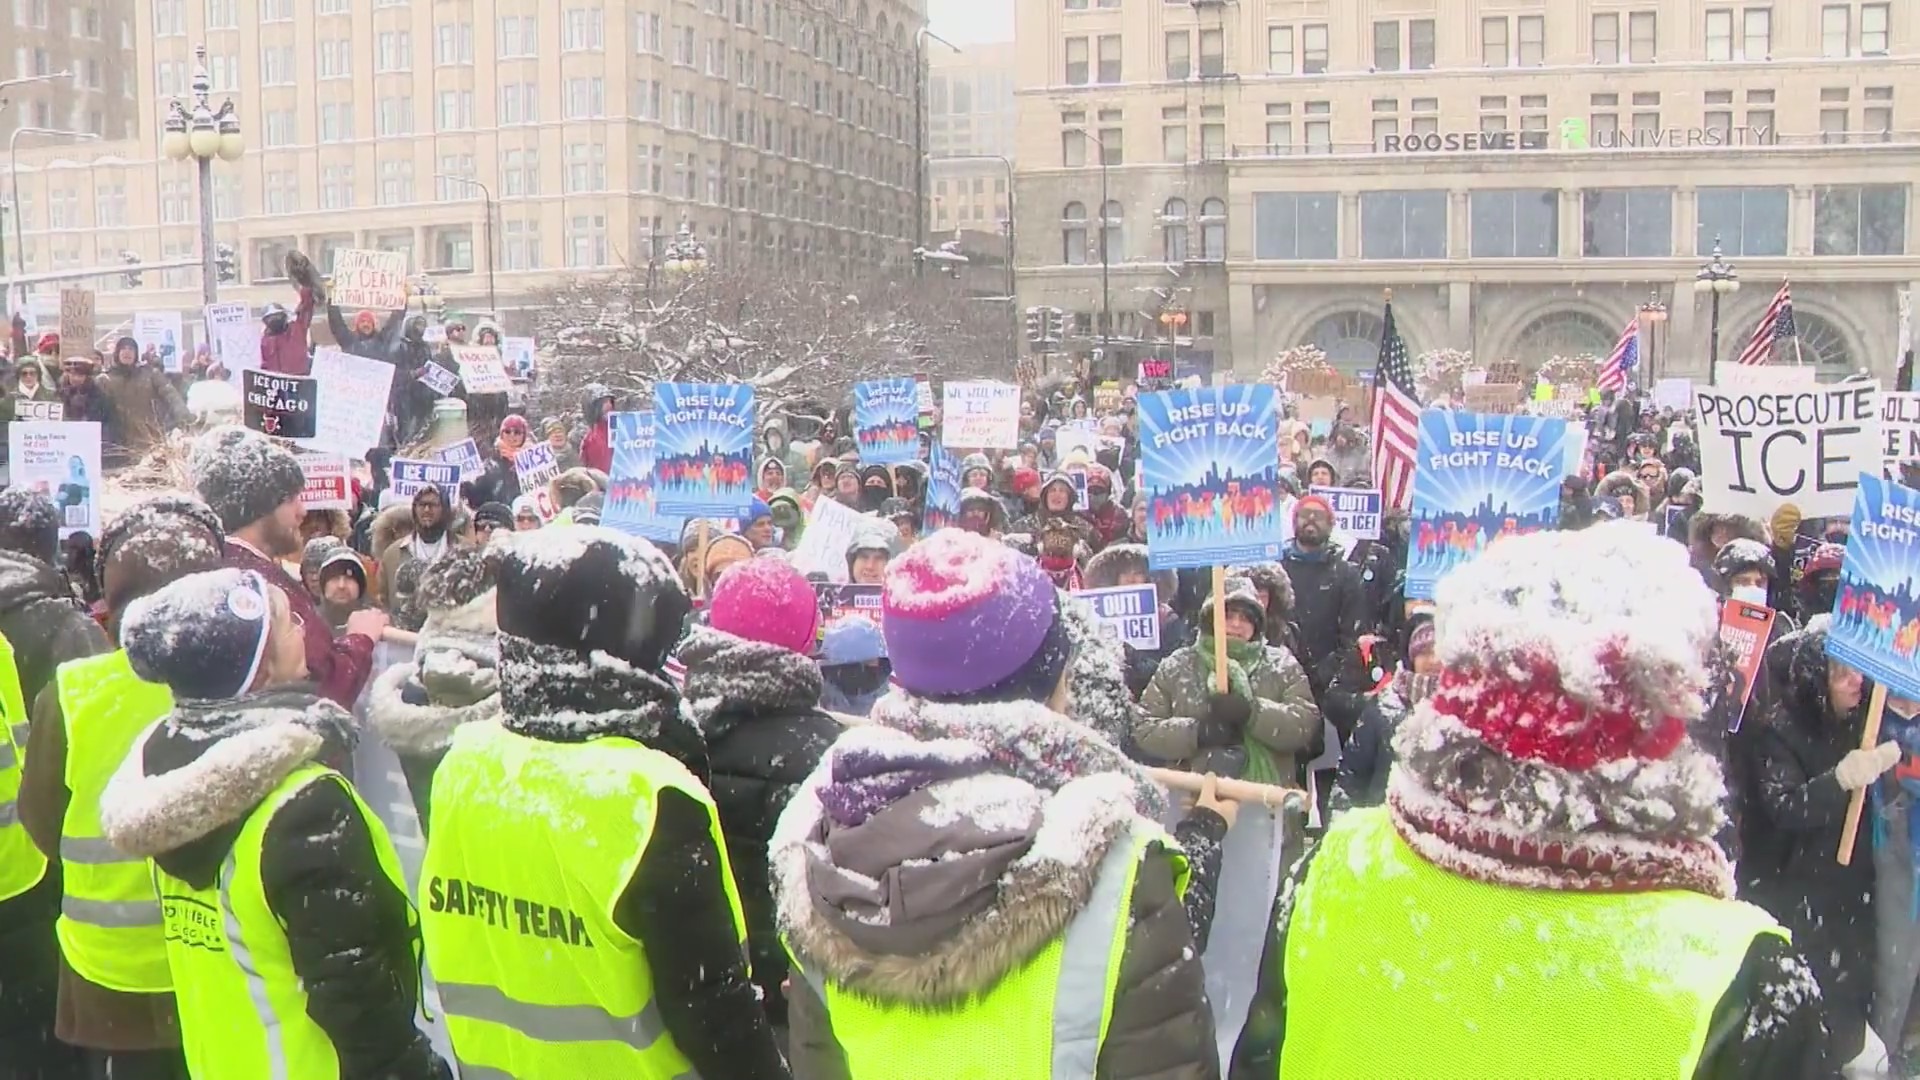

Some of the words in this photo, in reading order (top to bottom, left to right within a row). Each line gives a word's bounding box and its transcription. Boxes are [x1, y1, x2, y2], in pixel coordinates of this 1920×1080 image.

[1598, 125, 1769, 149] UNIVERSITY
[253, 375, 270, 388] ICE
[271, 380, 299, 392] OUT
[18, 402, 61, 421] ICE
[248, 391, 308, 412] CHICAGO
[675, 395, 710, 408] RISE
[713, 396, 736, 409] UP
[965, 401, 989, 414] ICE
[1697, 387, 1876, 427] PROSECUTE
[663, 409, 704, 427] FIGHT
[707, 409, 748, 428] BACK
[1168, 403, 1216, 423] RISE
[1221, 403, 1250, 417] UP
[636, 427, 656, 437] RIS
[1153, 422, 1210, 449] FIGHT
[1214, 421, 1269, 440] BACK
[1450, 431, 1500, 447] RISE
[1507, 433, 1538, 450] UP
[515, 444, 554, 473] NURSES
[1430, 451, 1492, 471] FIGHT
[1496, 453, 1553, 479] BACK
[1720, 426, 1861, 496] ICE
[403, 464, 422, 480] ICE
[425, 466, 451, 481] OUT!
[520, 465, 558, 493] AGAINST
[1338, 493, 1369, 512] OUT!
[1352, 515, 1377, 530] ICE!
[1861, 520, 1917, 547] FIGHT
[1103, 592, 1141, 617] OUT!
[1124, 617, 1154, 639] ICE!
[429, 876, 509, 930] SAFETY
[514, 898, 594, 948] TEAM
